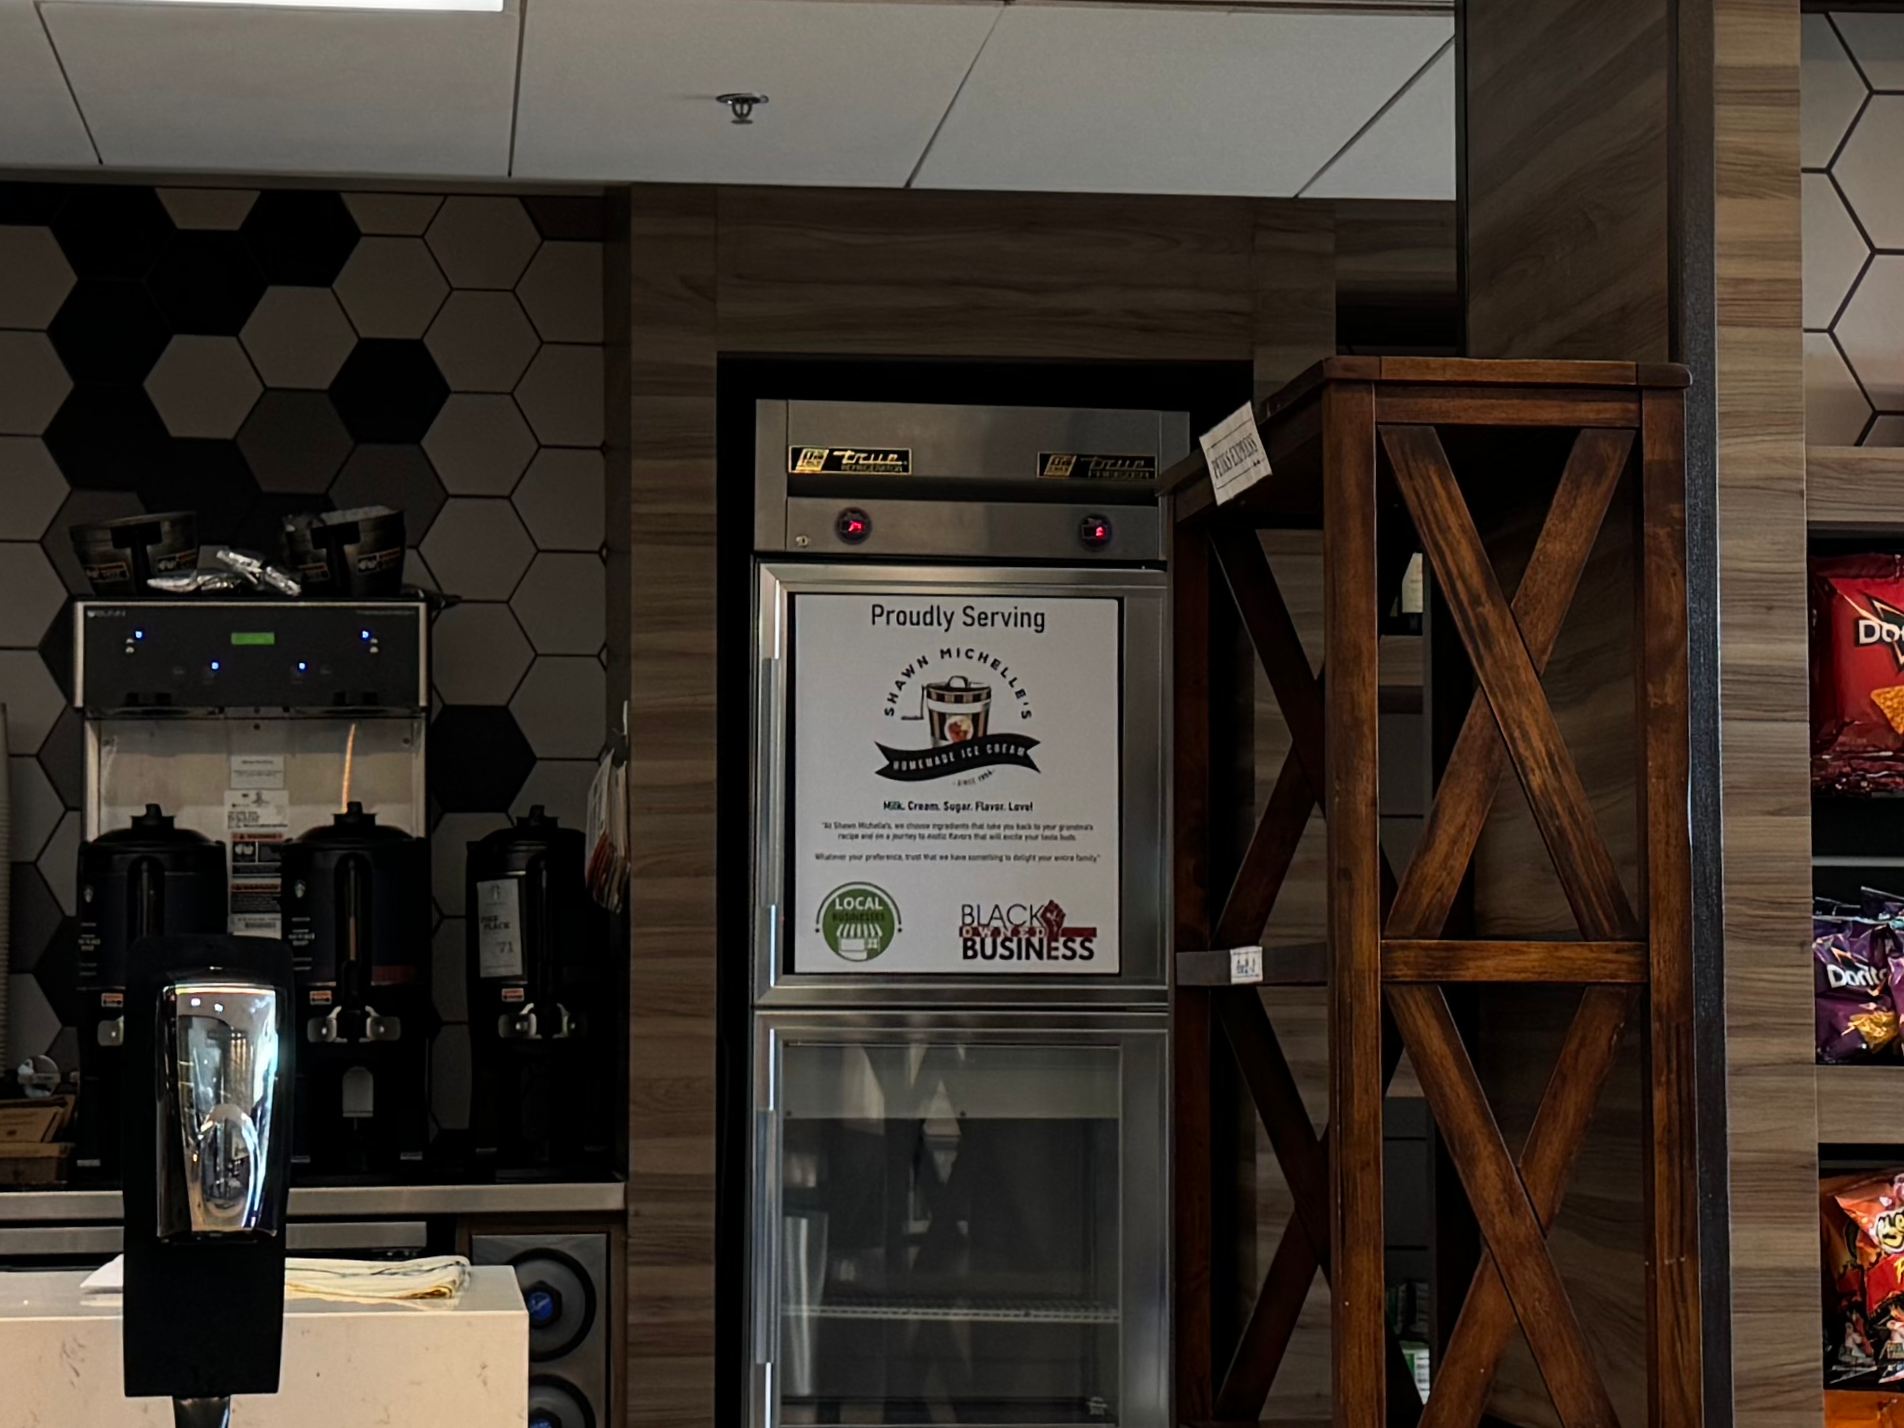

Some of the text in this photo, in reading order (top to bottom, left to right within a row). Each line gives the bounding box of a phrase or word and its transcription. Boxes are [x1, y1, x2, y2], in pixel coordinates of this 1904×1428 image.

[871, 603, 1046, 634] Proudly Serving
[884, 647, 1032, 720] SHAWN MICHELLE'S
[893, 743, 1026, 772] HOMEMADE ICE CREAM
[907, 801, 940, 811] Cream.
[944, 801, 973, 813] Sugar.
[832, 910, 885, 922] BUSINESSES
[835, 897, 883, 911] LOCAL
[961, 903, 1045, 927] BLACK
[962, 927, 1046, 939] OWNED
[962, 937, 1095, 961] BUSINESS
